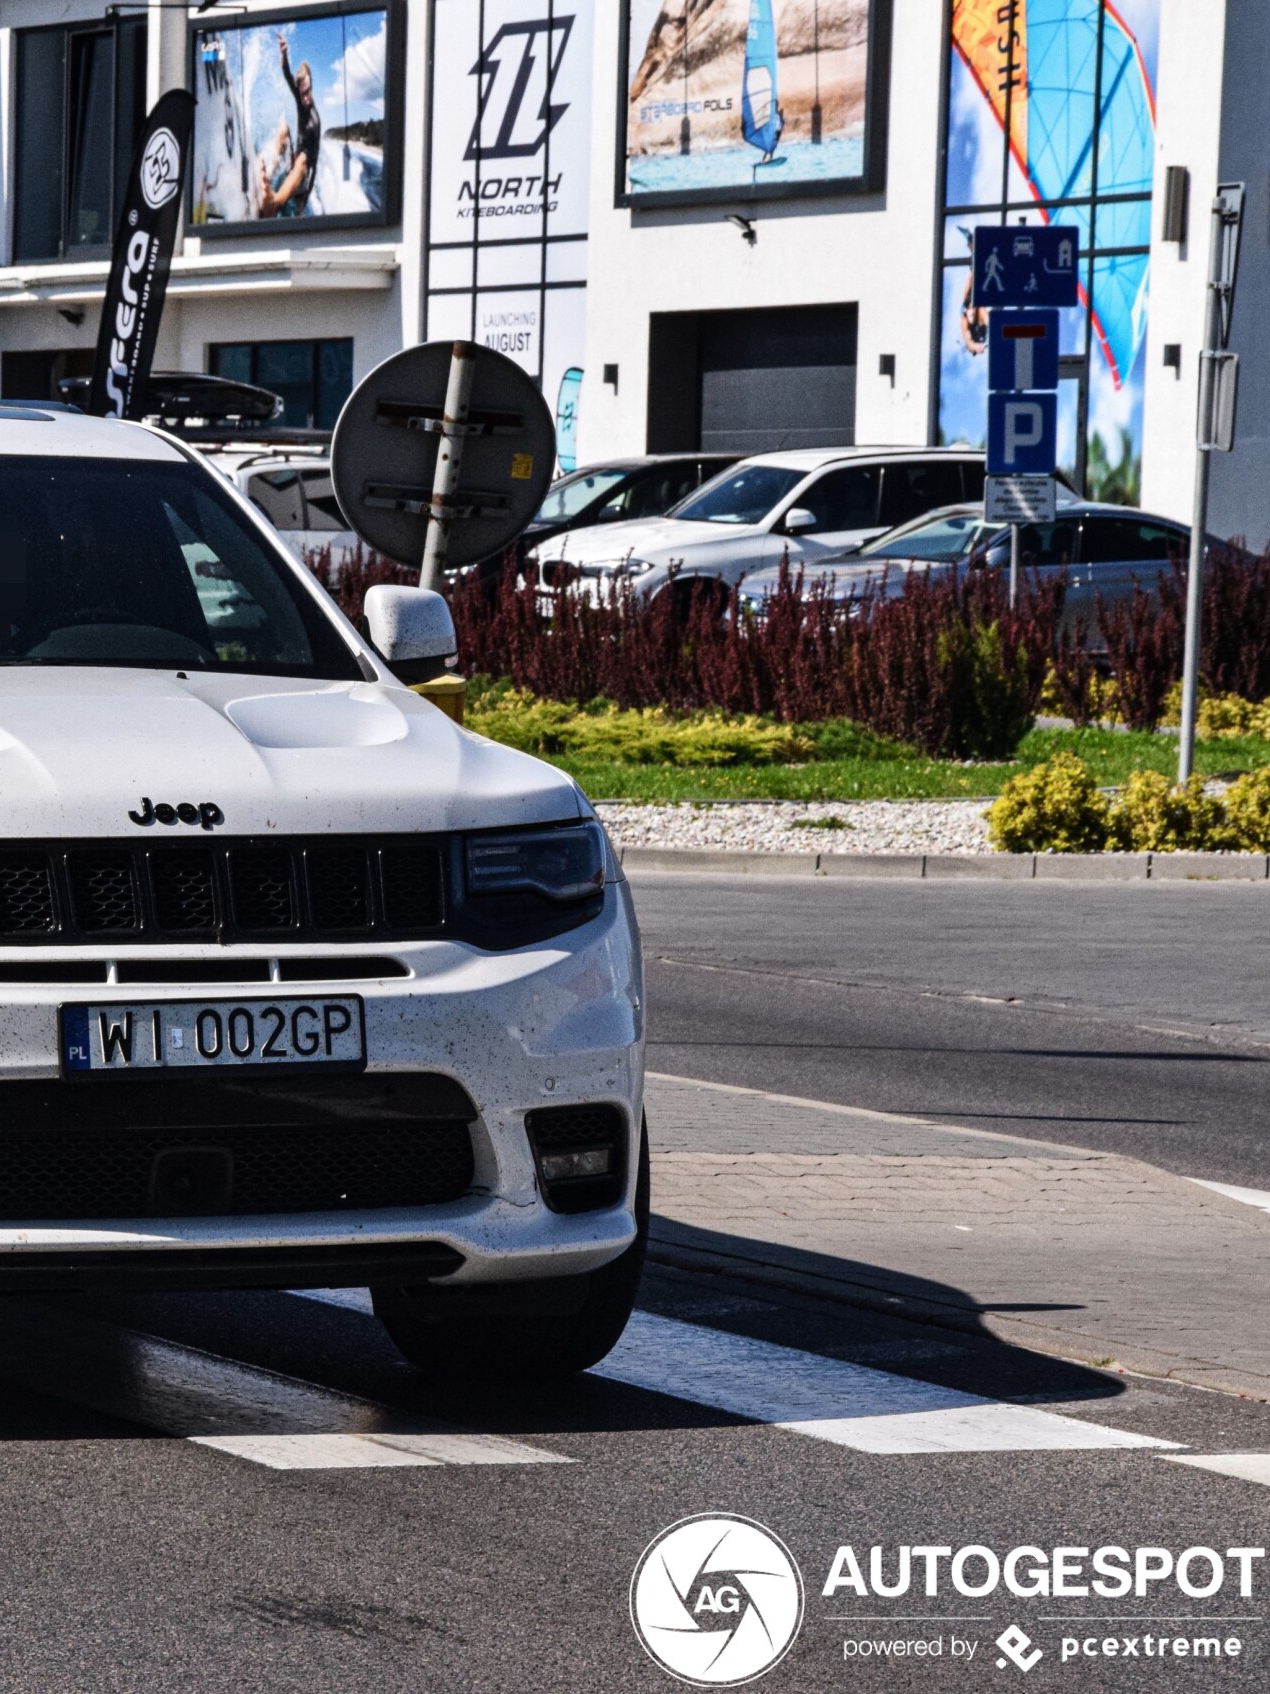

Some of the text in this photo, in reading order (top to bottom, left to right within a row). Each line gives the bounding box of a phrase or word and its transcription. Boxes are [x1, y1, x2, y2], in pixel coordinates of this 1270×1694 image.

[703, 98, 732, 112] FOILS
[458, 173, 562, 201] NORTH
[457, 201, 558, 218] KITEBOARDING
[148, 237, 160, 271] SURF
[483, 311, 536, 328] LAUNCHING
[485, 333, 531, 352] AUGUST
[1004, 402, 1043, 465] P
[128, 797, 224, 831] Jeep
[195, 1005, 352, 1059] 002GP
[69, 1046, 87, 1060] PL
